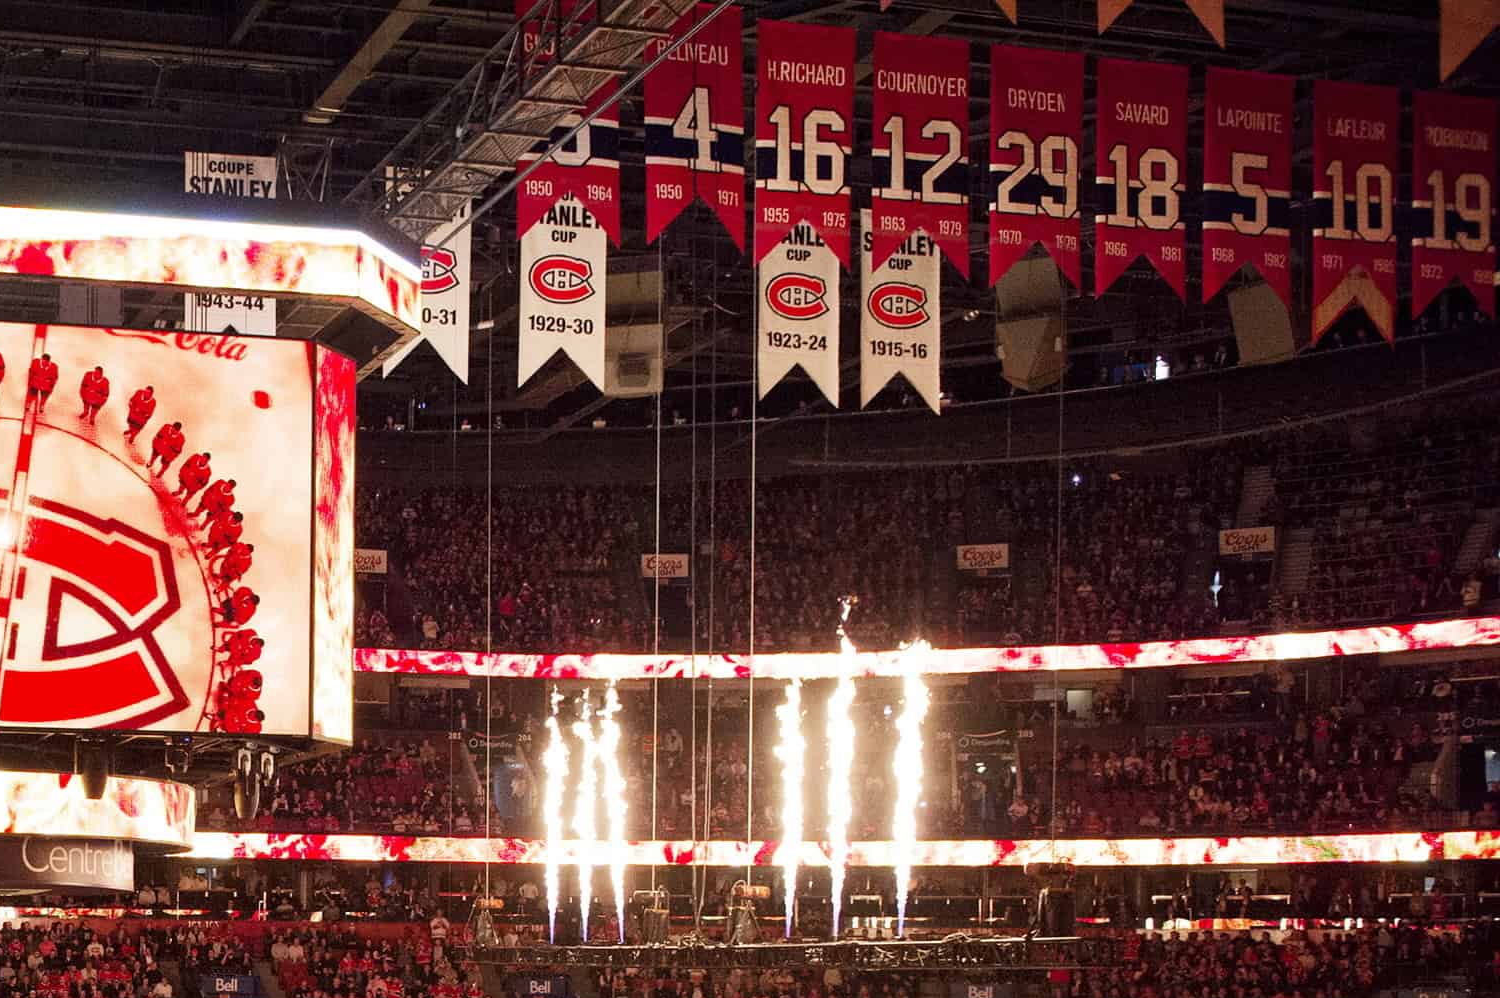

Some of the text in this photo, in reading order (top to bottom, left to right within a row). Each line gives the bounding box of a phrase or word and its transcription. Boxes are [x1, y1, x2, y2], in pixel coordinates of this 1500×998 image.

[767, 60, 846, 87] H.RICHARD
[877, 69, 967, 98] COURNOYER
[1007, 87, 1066, 113] DRYDEN
[1115, 101, 1169, 126] SAVARD
[1216, 106, 1283, 134] LAPOINTE
[671, 87, 719, 173] 4
[1326, 114, 1386, 142] LAFLEUR
[766, 104, 847, 195] 16
[881, 115, 964, 205] 12
[208, 159, 255, 176] COUPE
[996, 130, 1078, 218] 29
[188, 176, 273, 199] STANLEY
[525, 180, 553, 197] 1950
[586, 184, 613, 202] 1964
[655, 183, 683, 200] 1950
[717, 189, 739, 207] 1971
[1106, 143, 1180, 231] 18
[1230, 151, 1270, 236] 5
[1323, 159, 1392, 243] 10
[1425, 169, 1492, 253] 19
[763, 206, 846, 228] 1955 1975
[880, 215, 963, 236] 1963 1979
[551, 230, 577, 244] CUP
[786, 248, 812, 263] CUP
[1104, 240, 1182, 262] 1966 1981
[1211, 247, 1235, 263] 1968
[1322, 254, 1343, 270] 1971
[888, 256, 913, 271] CUP
[527, 314, 594, 335] 1929-30
[766, 330, 828, 352] 1923-24
[869, 339, 928, 359] 1915-16
[215, 978, 238, 992] Bell
[529, 980, 551, 994] Bell
